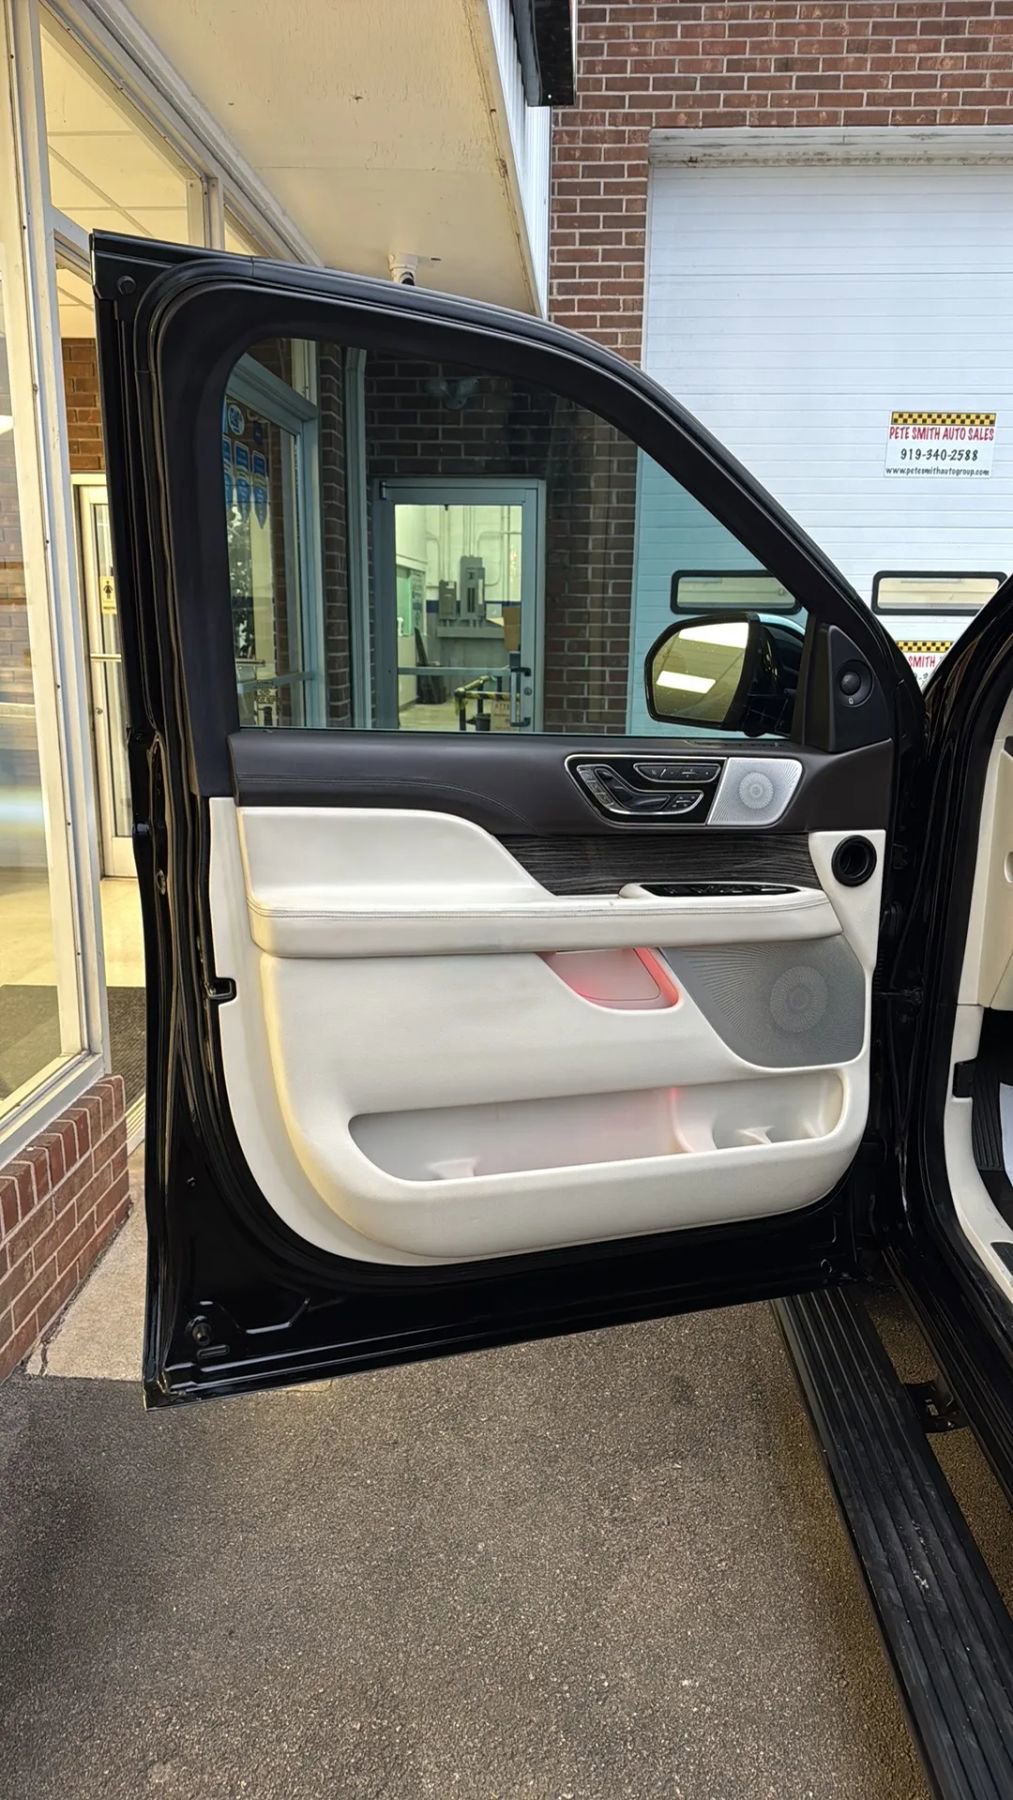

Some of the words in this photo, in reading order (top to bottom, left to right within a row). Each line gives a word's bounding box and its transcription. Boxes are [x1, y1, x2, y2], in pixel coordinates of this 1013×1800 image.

[889, 426, 910, 440] PETE
[912, 426, 940, 440] SMITH
[942, 427, 967, 441] AUTO
[968, 428, 994, 441] SALES
[900, 448, 979, 461] 919-340-2588
[886, 466, 990, 477] www.petesmithautogroup.com
[908, 655, 936, 668] SMITH
